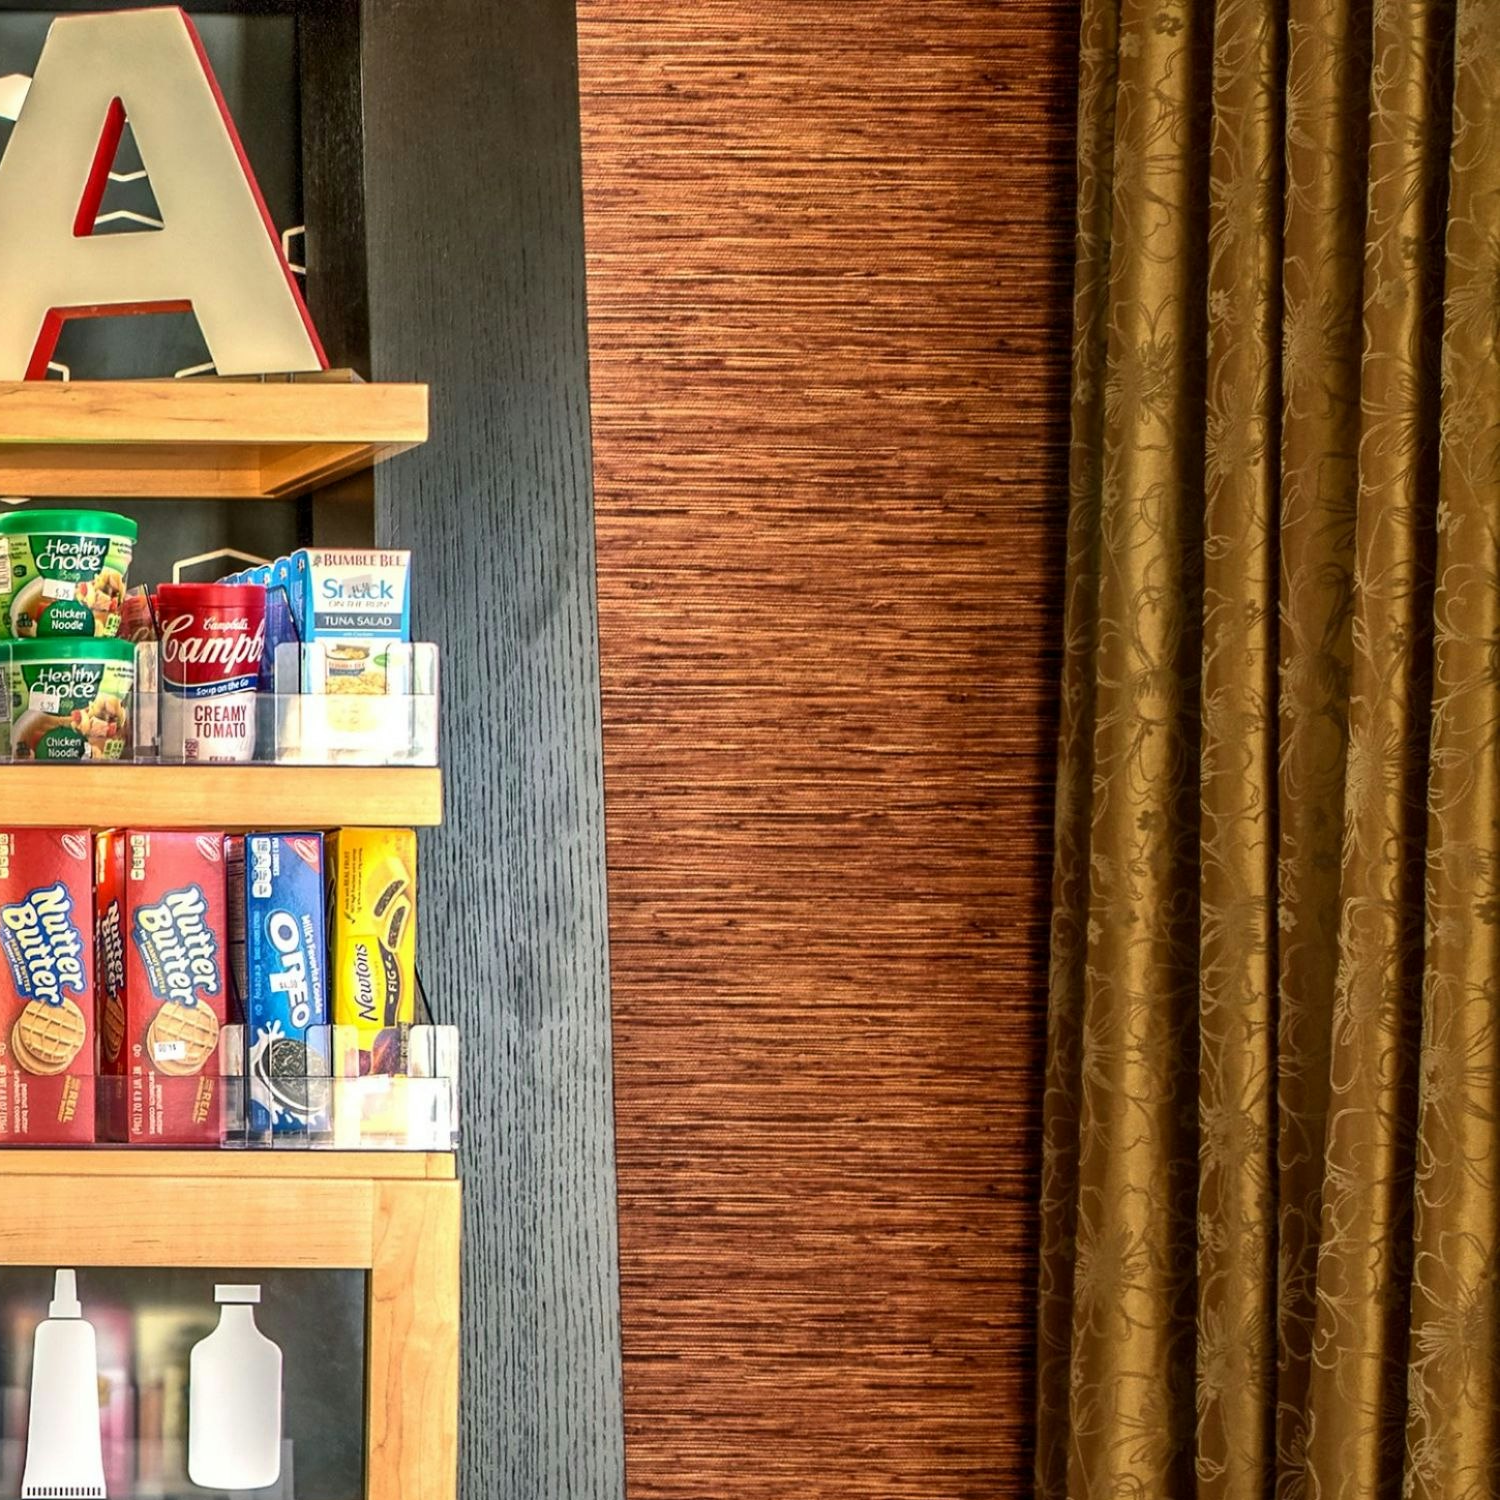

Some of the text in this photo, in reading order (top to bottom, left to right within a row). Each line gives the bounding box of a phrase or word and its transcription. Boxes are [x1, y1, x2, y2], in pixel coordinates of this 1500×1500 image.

[46, 537, 106, 556] Healthy
[36, 554, 101, 571] Choice
[324, 553, 403, 567] BUMBLE BEE
[49, 609, 87, 620] Chicken
[324, 615, 393, 626] TUNA SALAD
[51, 619, 84, 630] Noodle
[39, 664, 100, 683] Healthy
[30, 681, 96, 699] Choice
[195, 679, 249, 696] Soup on the Go
[194, 704, 248, 722] CREAMY
[194, 722, 246, 738] TOMATO
[46, 736, 82, 747] Chicken
[47, 747, 80, 758] Noodle
[30, 884, 85, 993] Nutter
[165, 887, 219, 995] Nutter
[1, 901, 63, 1006] Butter
[137, 904, 197, 1007] Butter
[264, 909, 312, 1029] OREO
[355, 943, 379, 1022] Newtons
